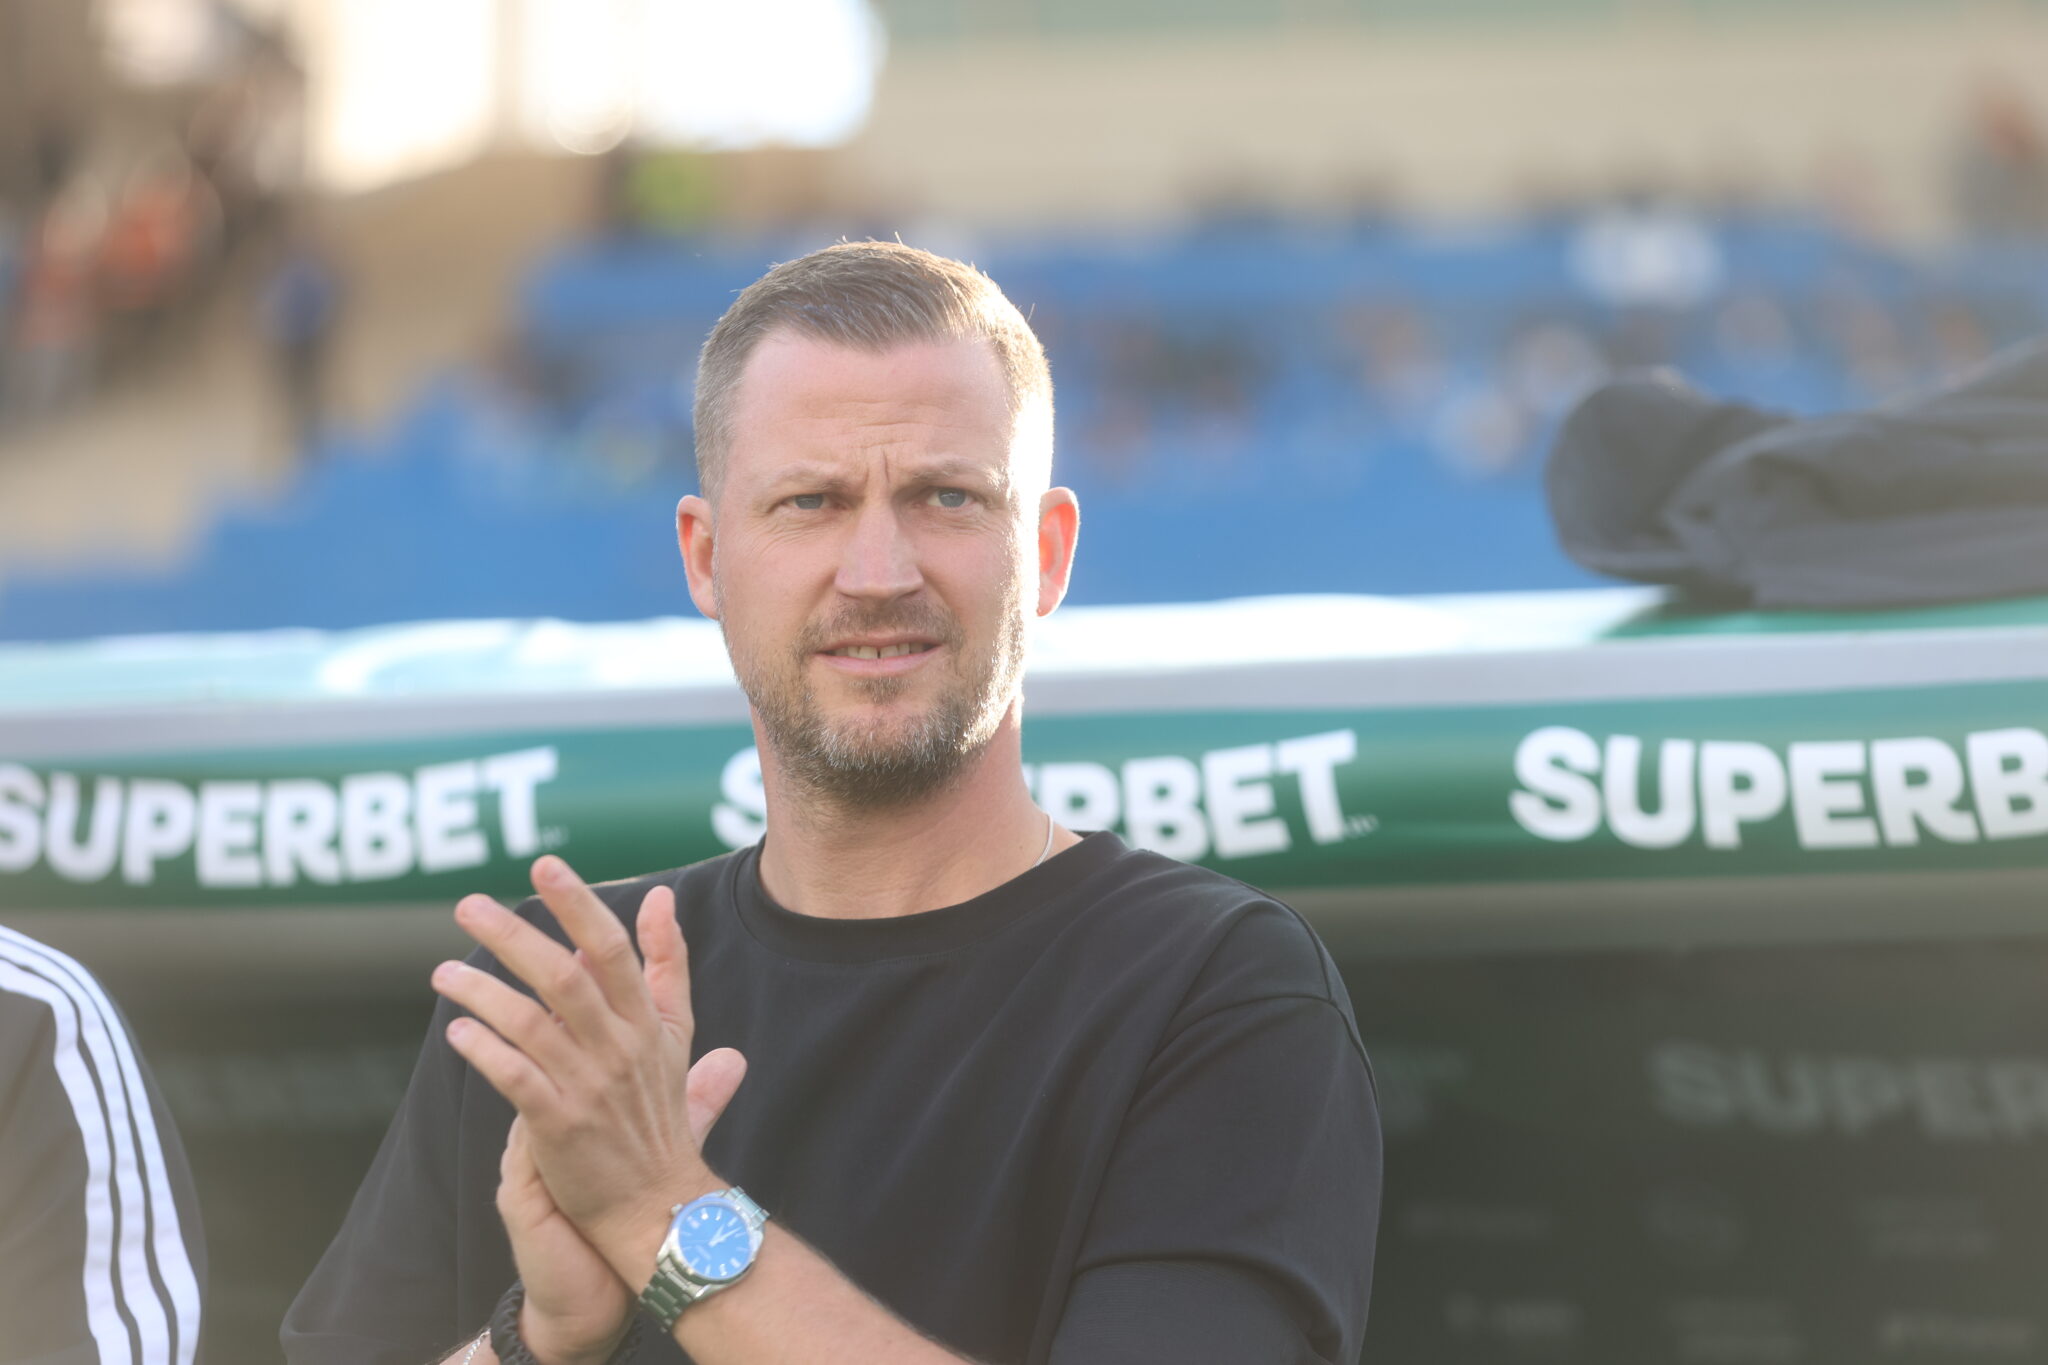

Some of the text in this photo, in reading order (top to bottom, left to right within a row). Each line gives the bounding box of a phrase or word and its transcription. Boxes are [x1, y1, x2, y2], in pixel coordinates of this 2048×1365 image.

[0, 746, 558, 887] SUPERBET
[710, 729, 1356, 863] SRBET
[1508, 726, 2048, 850] SUPERB
